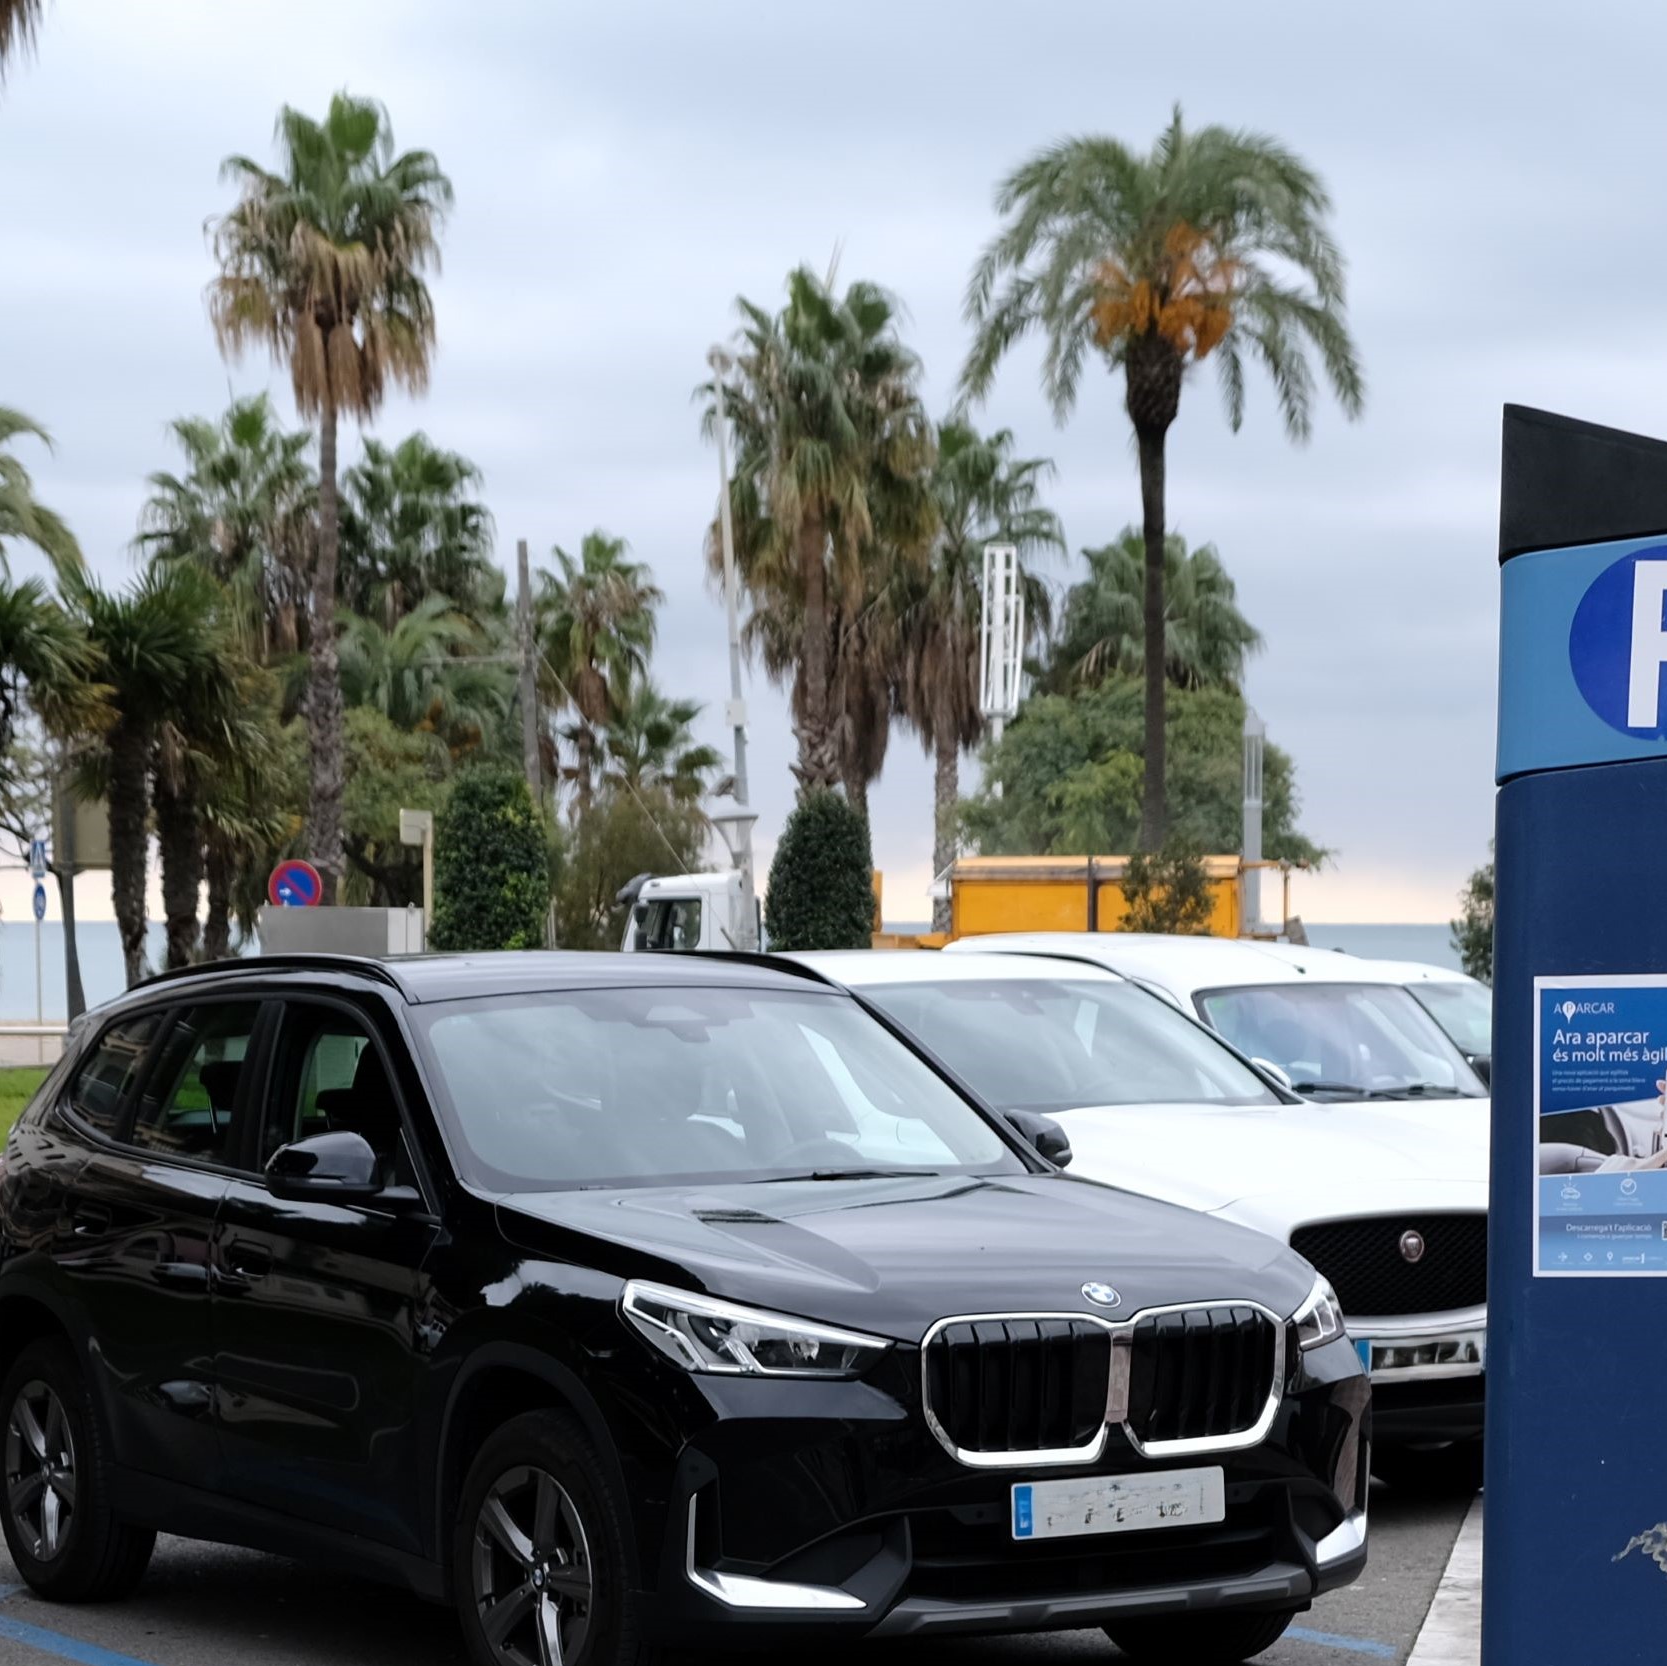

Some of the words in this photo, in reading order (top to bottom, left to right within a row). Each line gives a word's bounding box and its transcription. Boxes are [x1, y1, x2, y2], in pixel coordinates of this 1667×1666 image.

[1553, 1001, 1615, 1015] APARCAR
[1552, 1029, 1582, 1045] Ara
[1585, 1031, 1649, 1049] aparcar
[1552, 1048, 1569, 1063] és
[1571, 1048, 1606, 1062] molt
[1609, 1047, 1639, 1062] més
[1641, 1046, 1667, 1065] àgil
